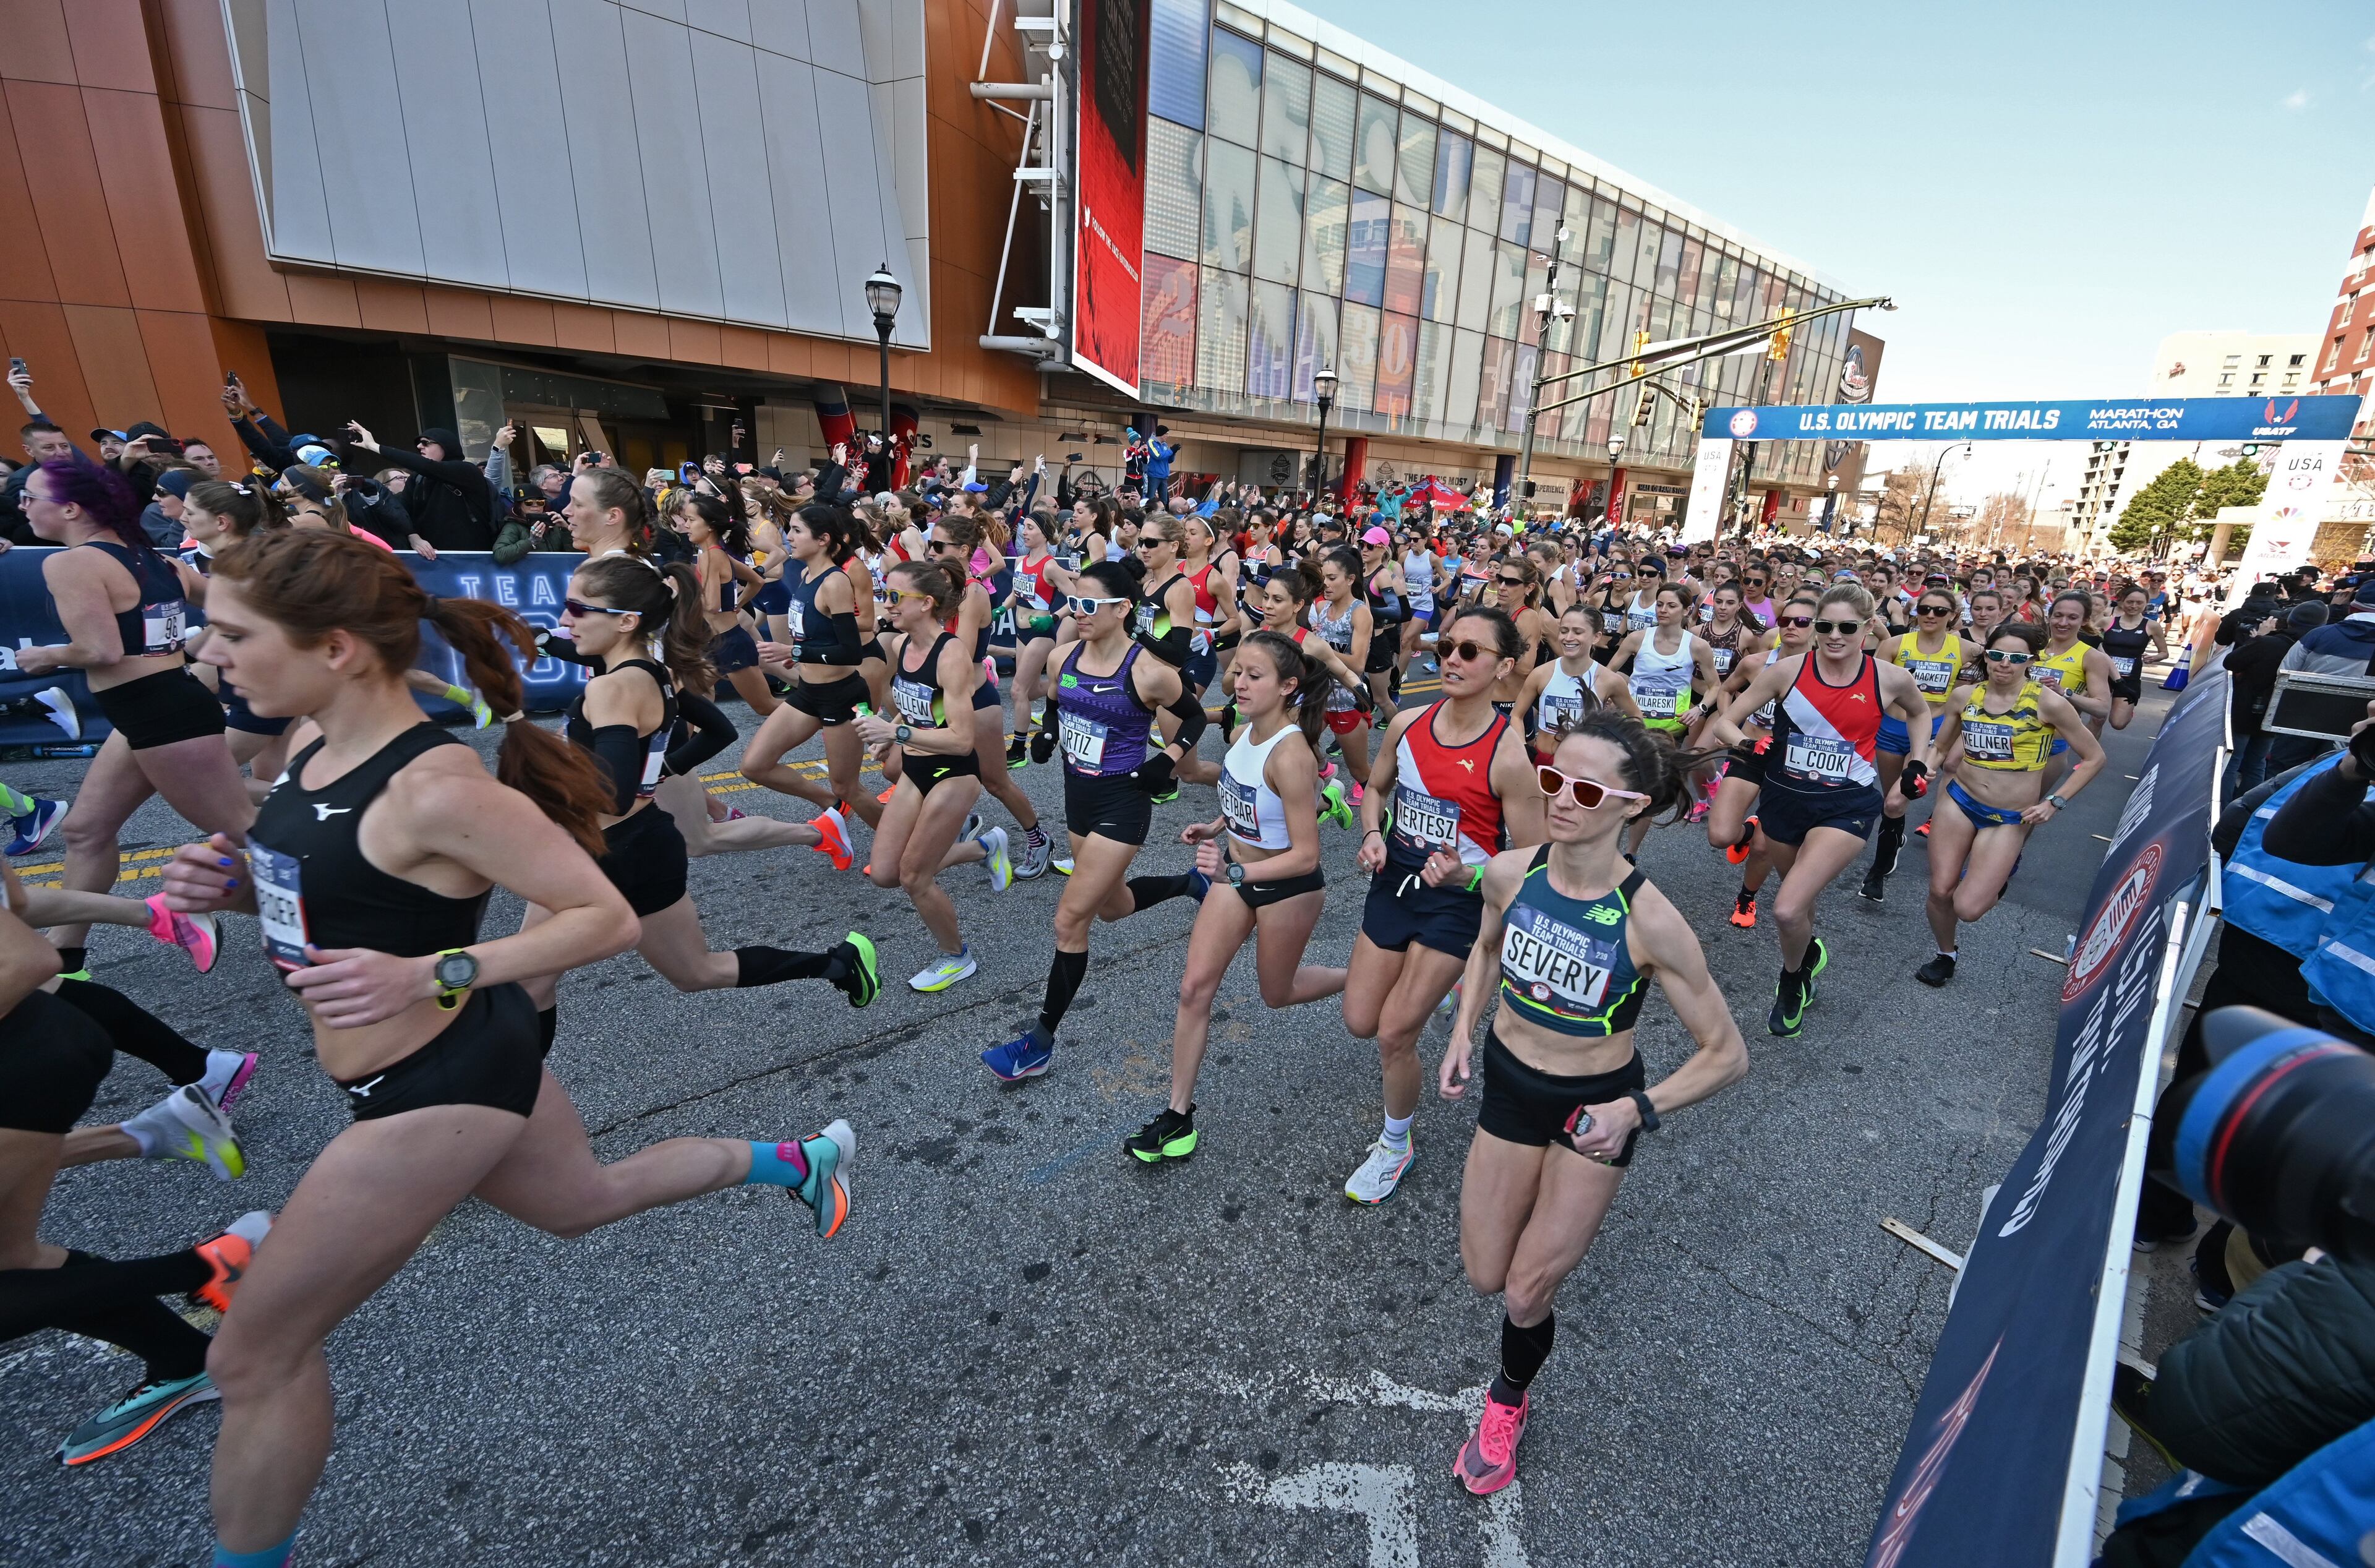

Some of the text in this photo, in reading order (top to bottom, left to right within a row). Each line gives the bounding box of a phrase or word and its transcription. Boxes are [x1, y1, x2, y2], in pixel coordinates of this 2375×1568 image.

[1799, 409, 2061, 431] U.S. OLYMPIC TEAM TRIALS
[2089, 408, 2184, 419] MARATHON
[2087, 419, 2178, 430] ATLANTA, GA
[2252, 427, 2298, 436] USATF
[1704, 451, 1722, 460] USA
[2288, 458, 2323, 471] USA
[1404, 473, 1418, 482] THE
[1449, 477, 1468, 487] MOST
[1535, 484, 1565, 494] XPERIENCE
[460, 576, 575, 606] TEA
[166, 616, 178, 640] 96
[1630, 620, 1645, 631] DEAR
[2115, 662, 2131, 671] GLEY
[1915, 672, 1949, 683] HACKETT
[1637, 696, 1674, 709] KILARESKI
[1063, 718, 1090, 734] TEAM TRIALS
[1072, 715, 1092, 728] OLYMPIC
[1063, 726, 1092, 756] ORTIZ
[1802, 742, 1838, 753] TEAM TRIALS
[1813, 738, 1839, 747] OLYMPIC
[1963, 732, 2010, 750] KELLNER
[1788, 745, 1847, 772] L. COOK
[1218, 784, 1254, 824] TRETBAR
[1406, 790, 1440, 808] U.S. OLYMPIC
[1406, 797, 1440, 815] TEAM TRIALS
[1398, 798, 1454, 841] KERTESZ
[1535, 915, 1590, 948] U.S. OLYMPIC
[1531, 925, 1586, 959] TEAM TRIALS
[1507, 929, 1602, 996] SEVERY
[1595, 951, 1609, 961] 239
